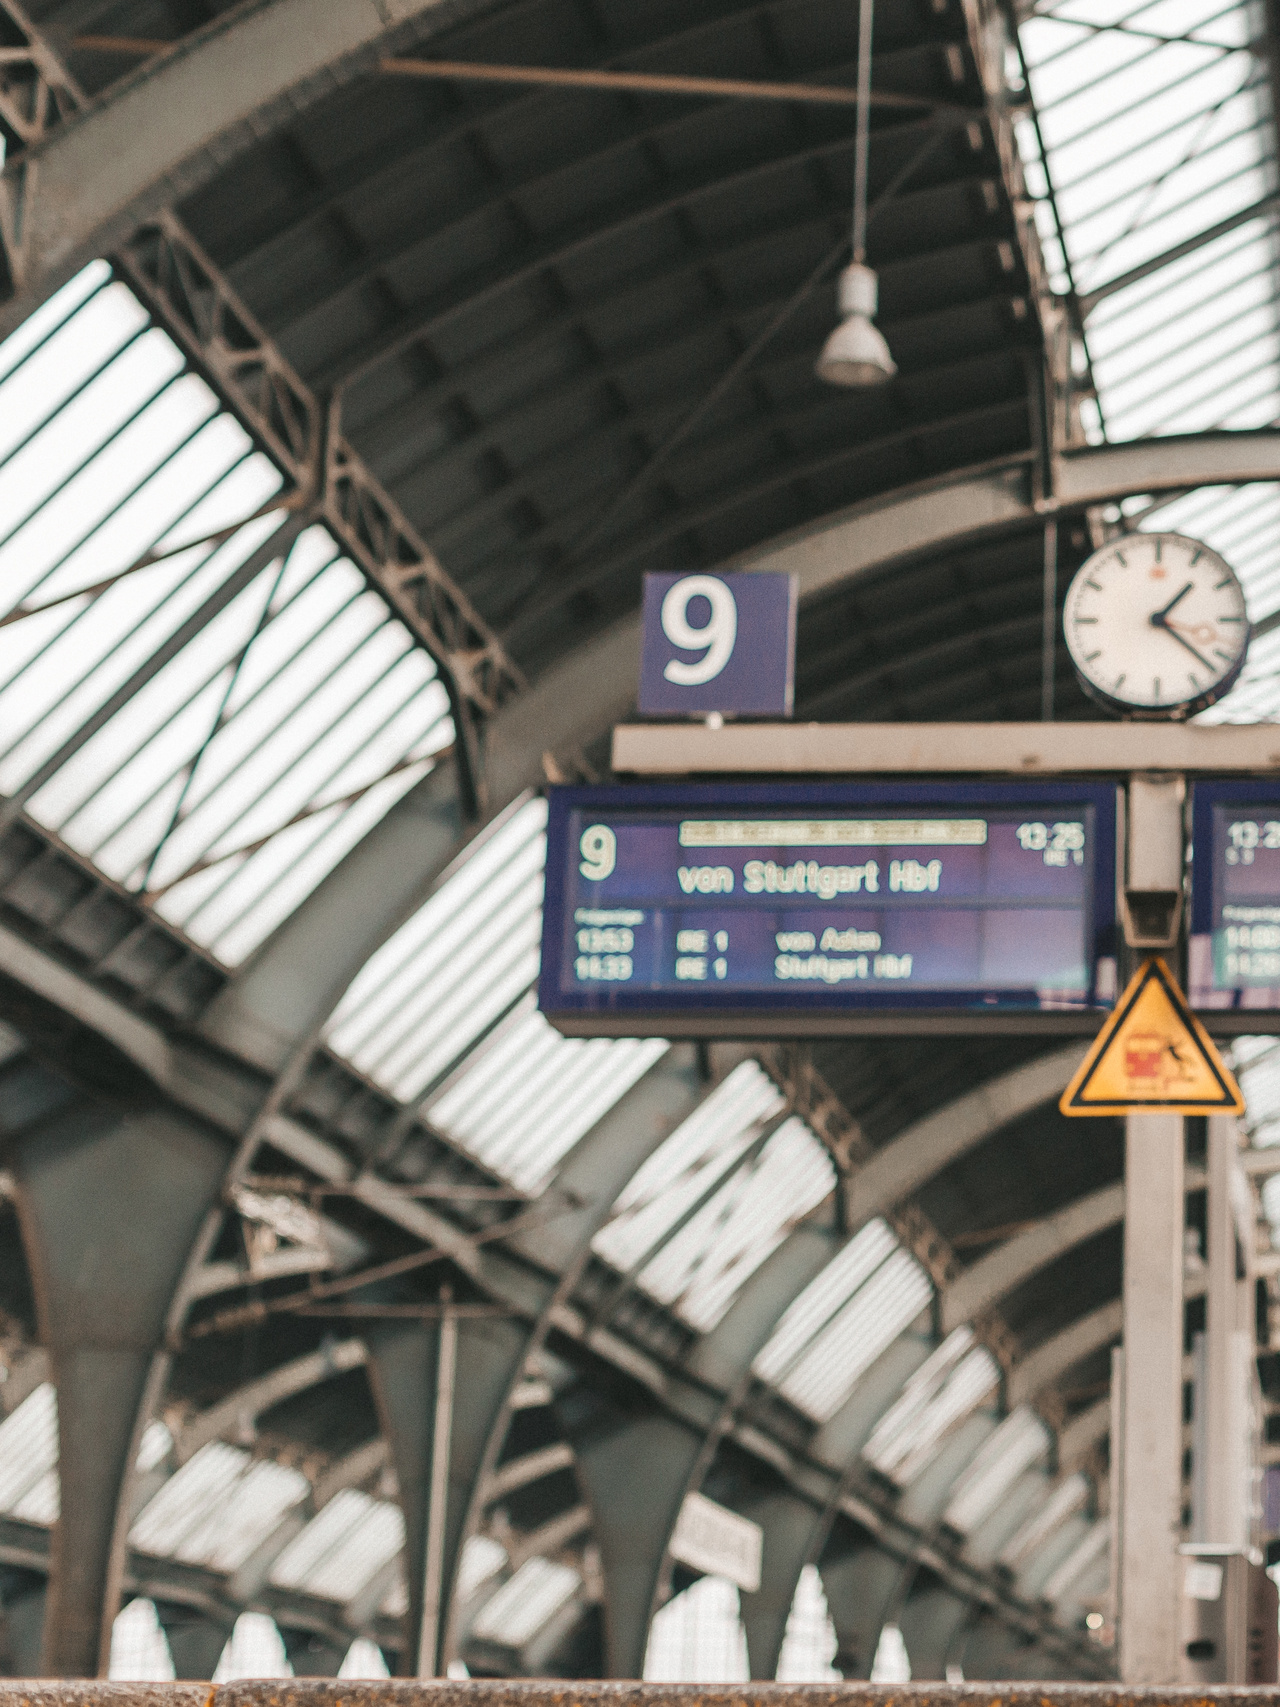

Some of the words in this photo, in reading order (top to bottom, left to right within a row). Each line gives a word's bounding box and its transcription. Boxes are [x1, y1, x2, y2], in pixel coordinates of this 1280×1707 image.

[661, 575, 737, 686] 9
[579, 823, 617, 881] 9
[677, 865, 735, 894] von
[743, 860, 880, 900] Stuttgart
[889, 859, 943, 892] Hbf
[714, 930, 729, 952] 1
[775, 931, 816, 951] von
[713, 957, 728, 980] 1
[774, 954, 869, 984] Stuttgart
[873, 953, 914, 979] Hbf
